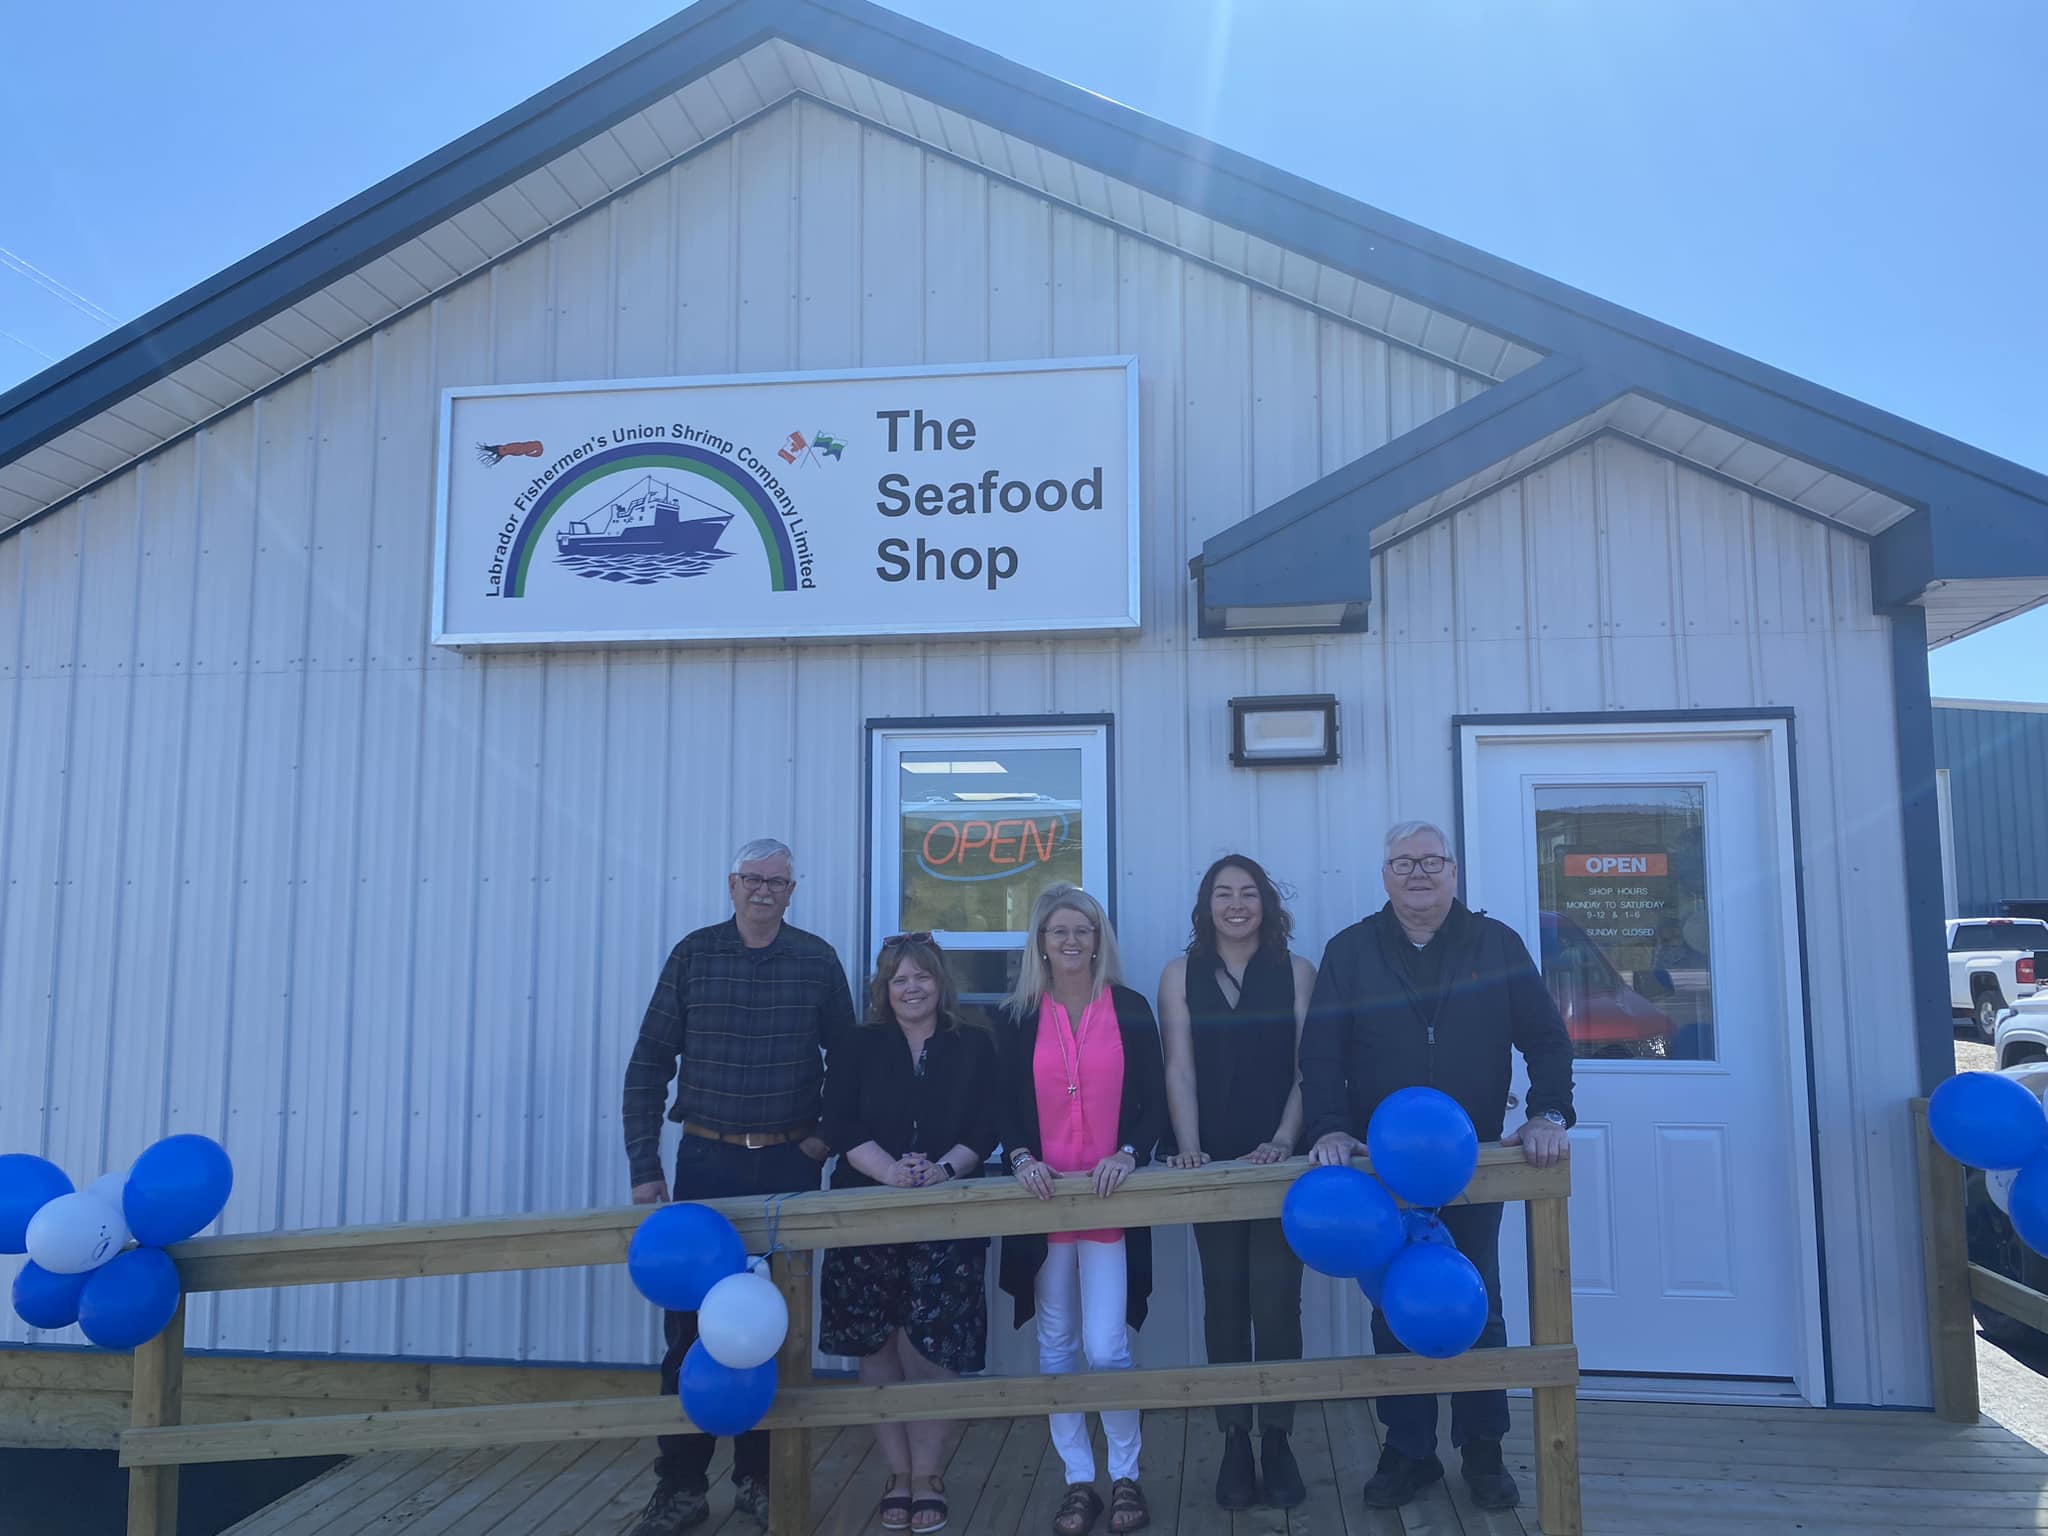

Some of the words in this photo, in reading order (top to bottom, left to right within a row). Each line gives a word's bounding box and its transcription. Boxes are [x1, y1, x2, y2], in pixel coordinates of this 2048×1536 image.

[876, 409, 977, 452] The
[486, 514, 519, 598] Labrador
[513, 436, 608, 512] Fishermen's
[612, 424, 666, 444] Union
[671, 423, 734, 455] Shrimp
[737, 446, 799, 518] Company
[789, 518, 816, 590] Limited
[876, 466, 1103, 518] Seafood
[875, 537, 1019, 591] Shop
[922, 818, 1057, 866] OPEN
[1585, 856, 1647, 874] OPEN
[1566, 900, 1601, 910] MONDAY
[1605, 901, 1617, 910] TO
[1620, 900, 1665, 910] SATURDAY
[1588, 887, 1614, 896] SHOP
[1617, 887, 1649, 896] HOURS
[1586, 927, 1618, 937] SUNDAY
[1622, 927, 1655, 937] CLOSED
